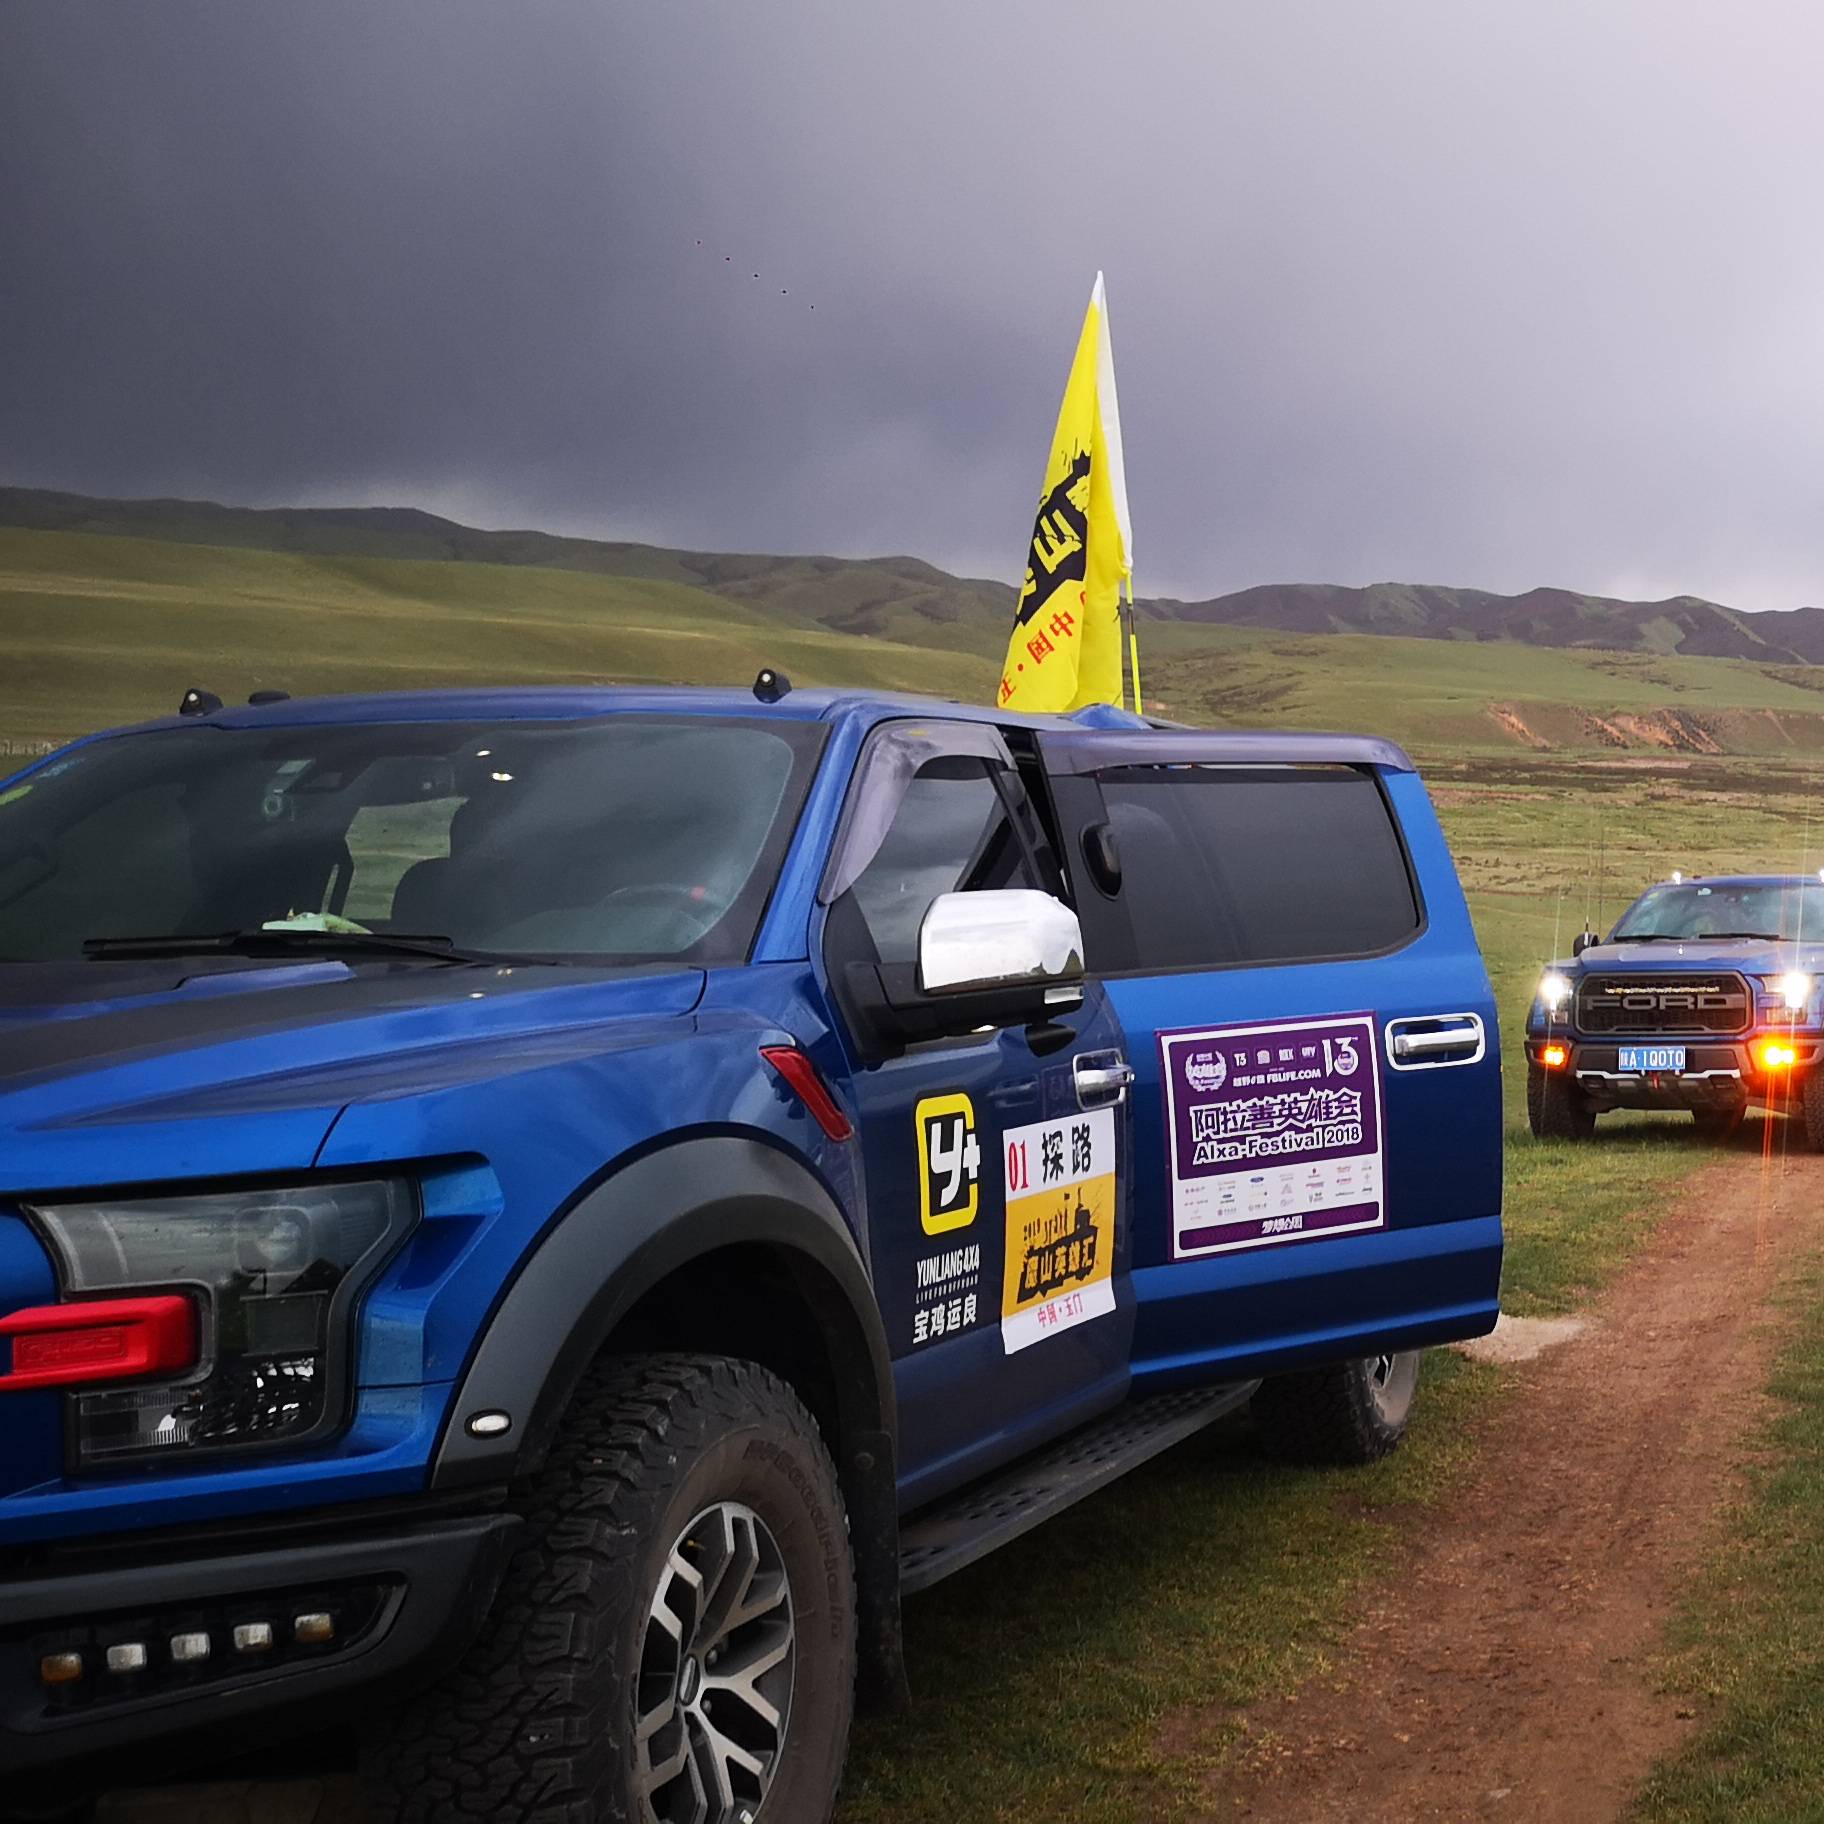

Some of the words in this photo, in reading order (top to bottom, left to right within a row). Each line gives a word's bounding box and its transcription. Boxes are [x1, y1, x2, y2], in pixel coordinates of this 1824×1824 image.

[1586, 993, 1738, 1011] FORD
[1191, 1090, 1359, 1139] 阿拉善英雄会
[1325, 1126, 1360, 1144] 2018
[1008, 1139, 1029, 1192] 01
[1042, 1123, 1091, 1184] 探路
[912, 1292, 977, 1344] 宝鸡运良
